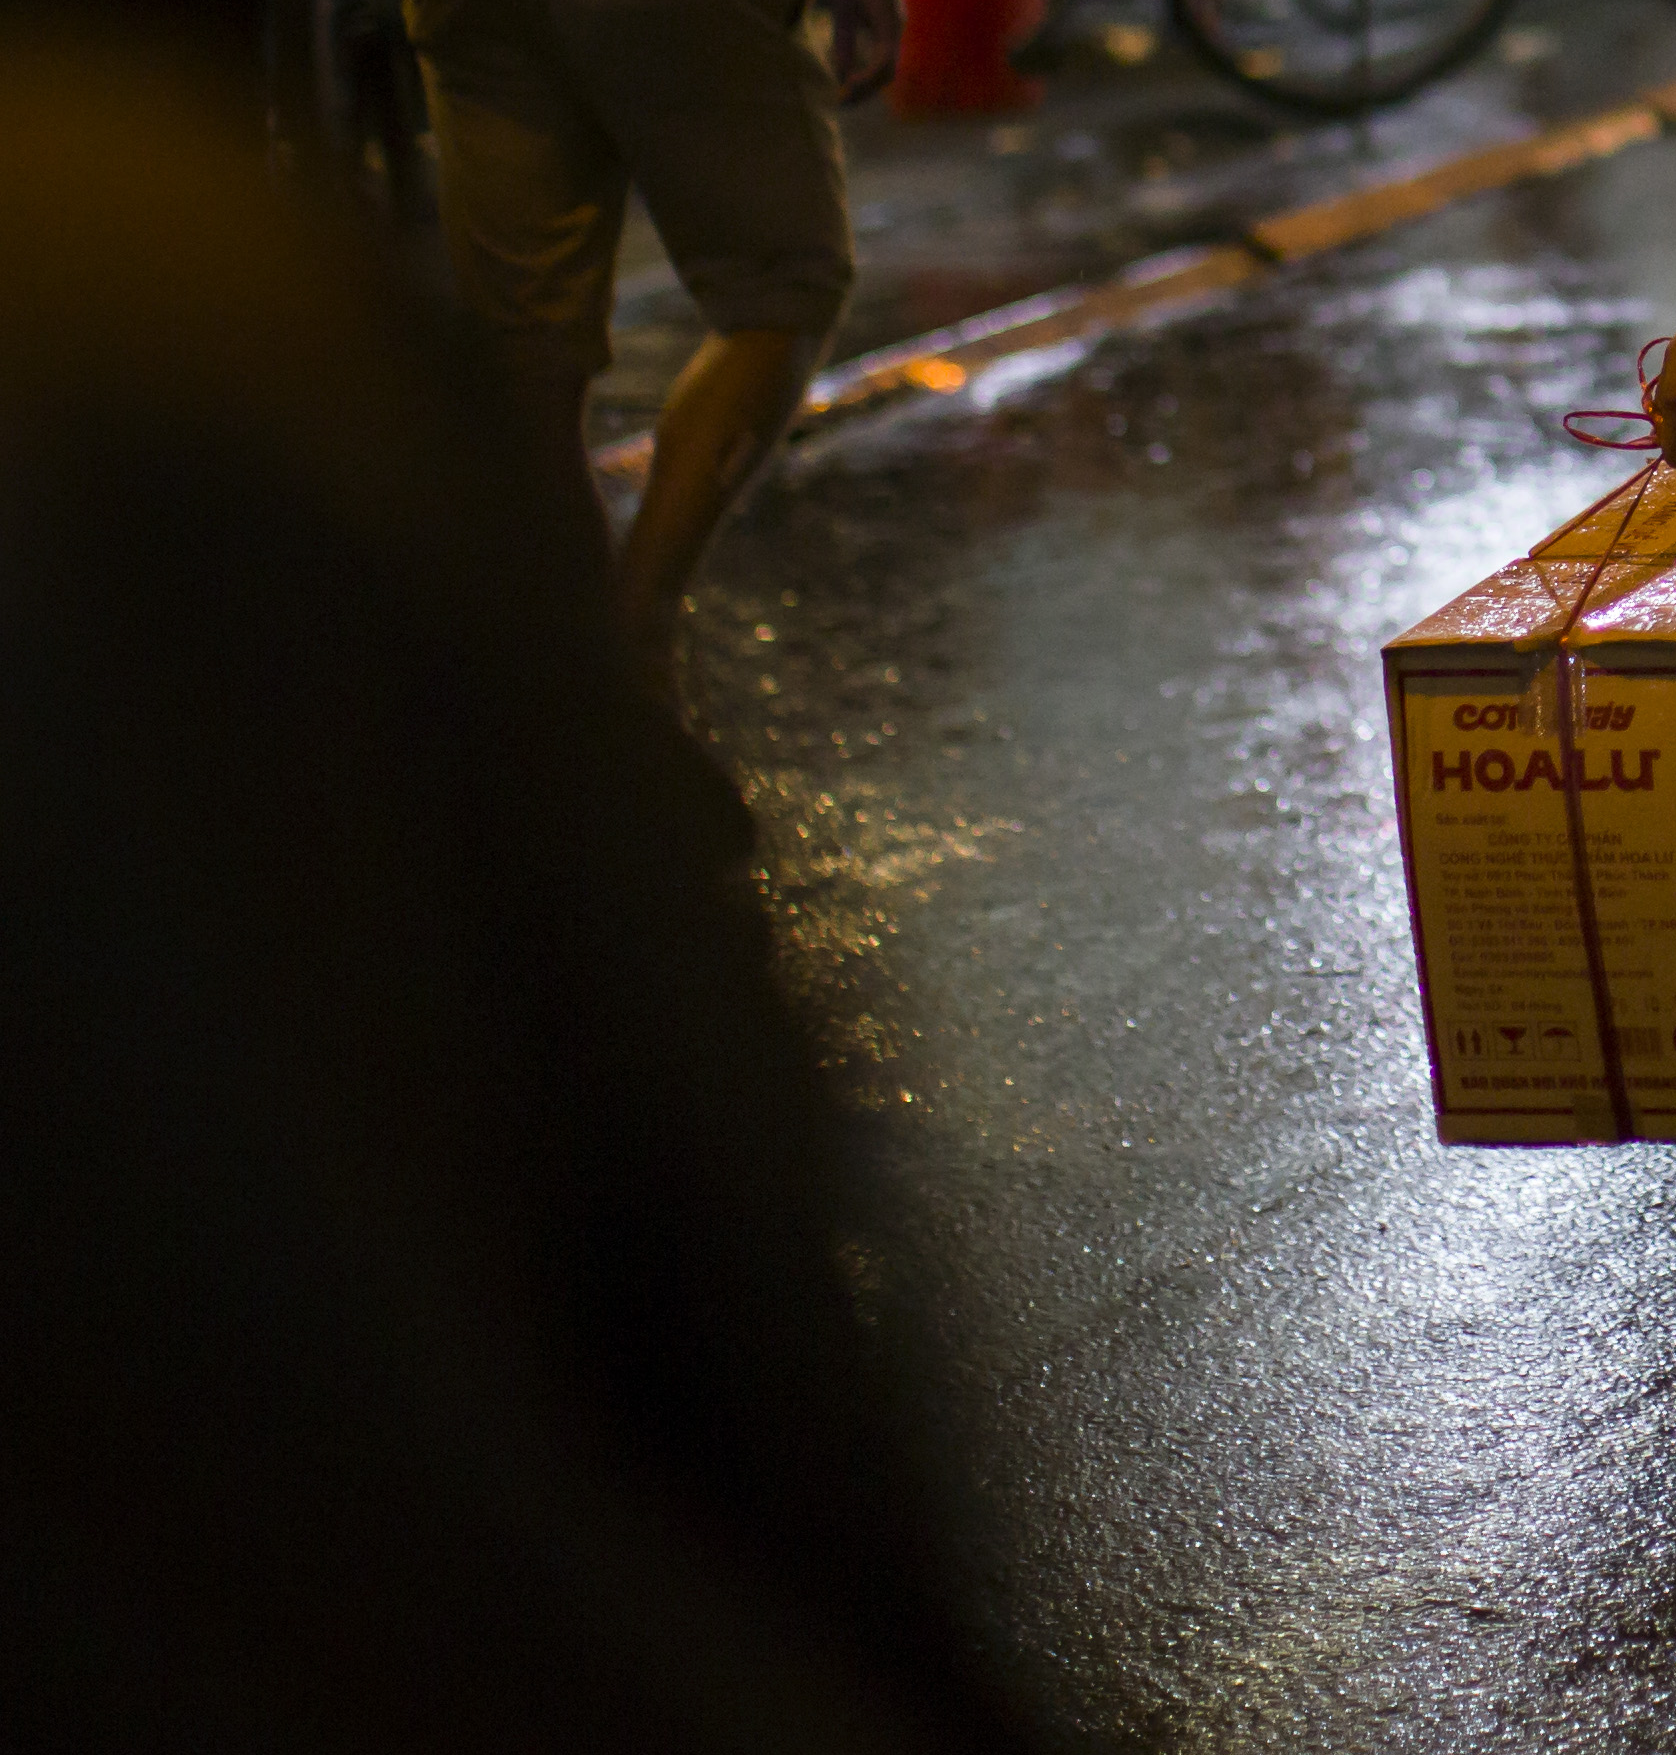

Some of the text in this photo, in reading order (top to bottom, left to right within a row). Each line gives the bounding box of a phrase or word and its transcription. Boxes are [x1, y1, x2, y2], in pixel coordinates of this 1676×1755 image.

[1487, 830, 1530, 846] CÔNG
[1535, 832, 1553, 845] TY
[1619, 851, 1650, 865] HOA
